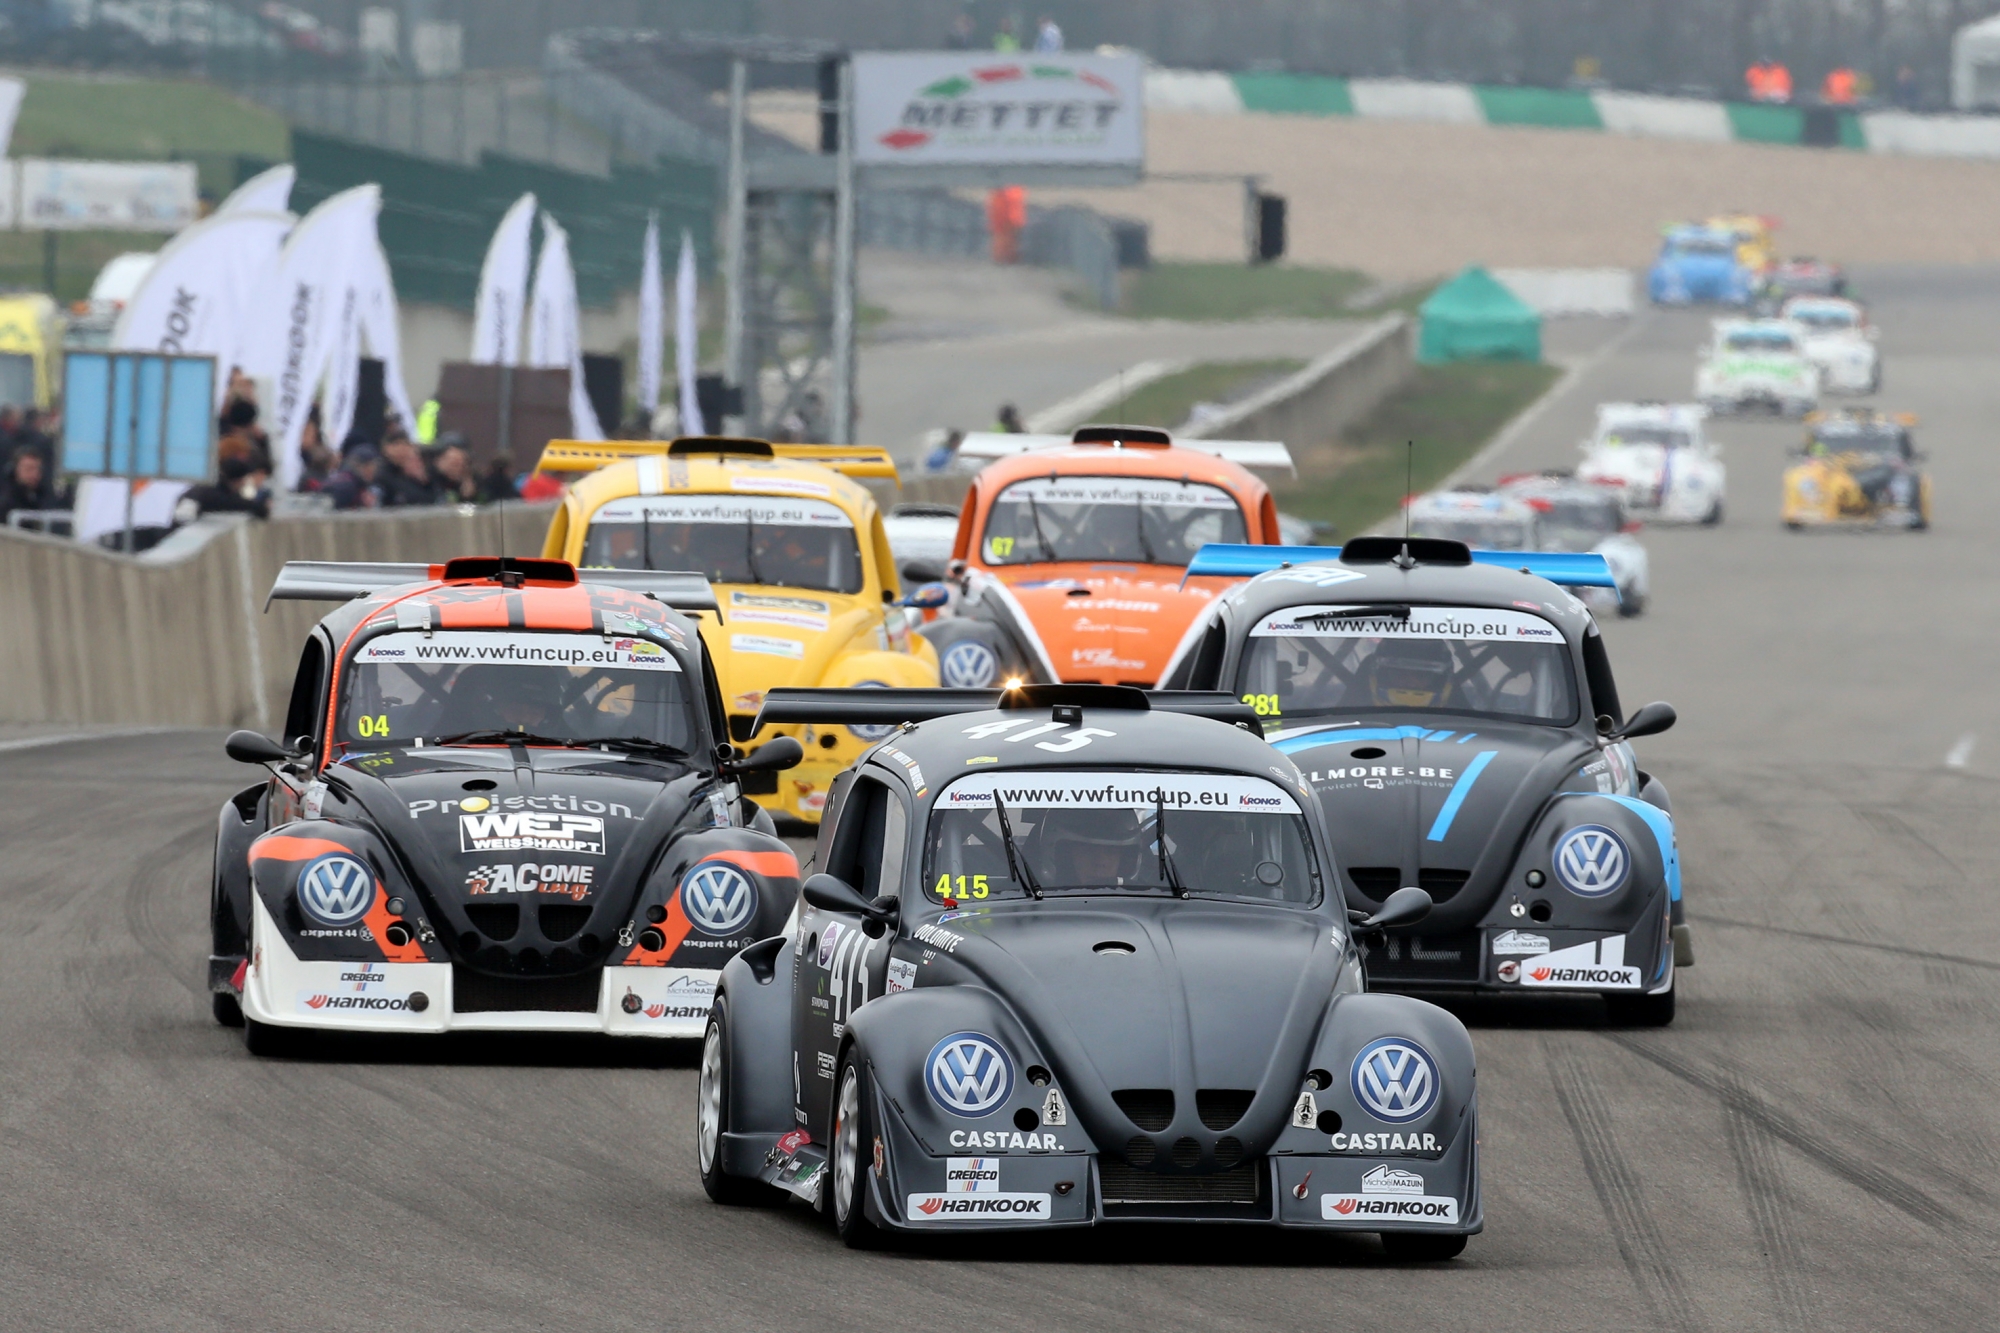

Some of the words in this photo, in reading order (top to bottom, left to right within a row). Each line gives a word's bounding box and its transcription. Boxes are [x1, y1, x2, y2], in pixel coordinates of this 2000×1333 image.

[900, 100, 1119, 130] METTET
[991, 537, 1014, 556] 67
[1268, 621, 1305, 631] KRONOS
[1314, 619, 1507, 638] www.vwfuncup.eu
[1516, 625, 1553, 637] KRONOS
[368, 646, 406, 657] KRONOS
[416, 644, 618, 665] www.vwfuncup.eu
[628, 653, 666, 664] KRONOS
[358, 715, 390, 737] 04
[961, 719, 1118, 753] 415
[949, 789, 992, 802] KRONOS
[1003, 786, 1229, 808] www.vwfuncup.eu
[1239, 793, 1281, 805] KRONOS
[462, 813, 602, 839] WEP
[472, 837, 601, 852] WEISSHAUPT
[935, 873, 989, 899] 415
[300, 929, 343, 939] expert
[345, 929, 358, 938] 44
[914, 923, 965, 953] DOLOMITE
[683, 939, 724, 948] expert
[726, 940, 738, 948] 44
[340, 973, 385, 982] CREDECO
[949, 1130, 1065, 1151] CASTAAR.
[1331, 1133, 1442, 1151] CASTAAR.
[948, 1170, 998, 1180] CREDECO
